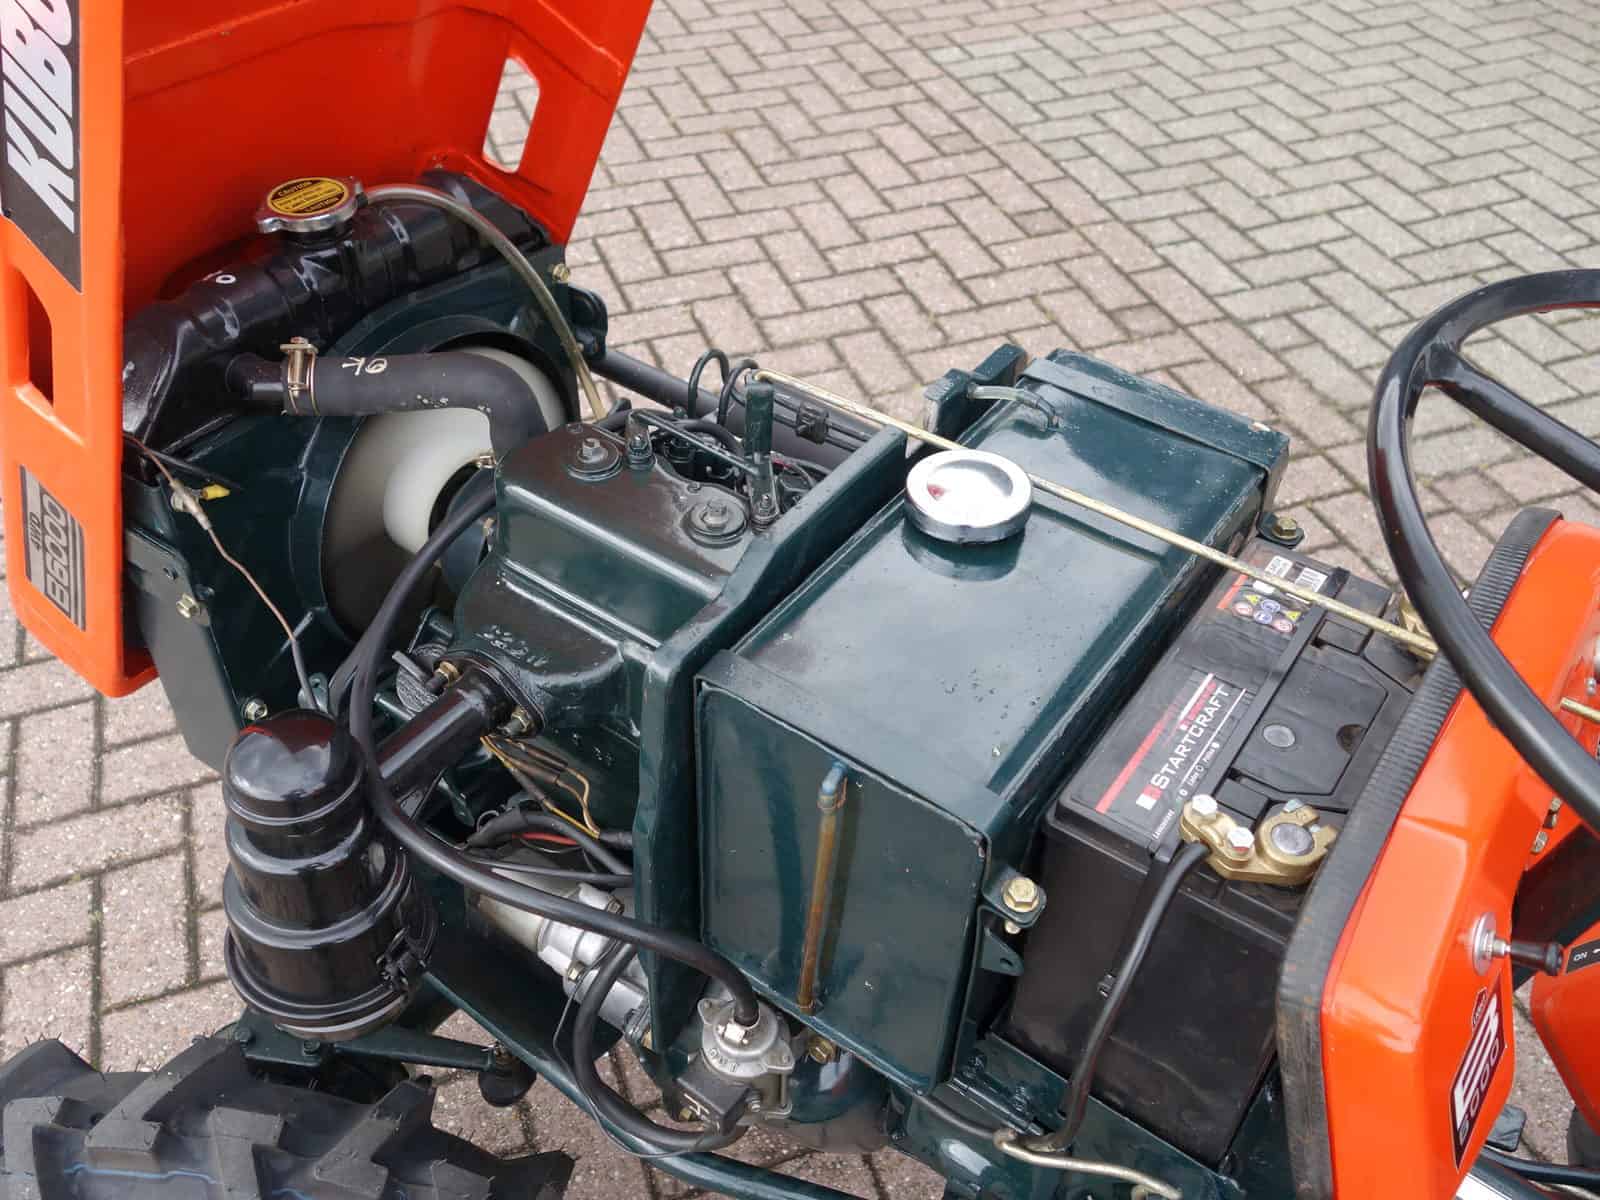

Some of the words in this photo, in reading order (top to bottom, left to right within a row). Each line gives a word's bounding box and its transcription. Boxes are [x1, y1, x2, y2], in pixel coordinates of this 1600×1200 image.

[42, 493, 70, 614] B6000
[1151, 684, 1229, 790] STARTCRAFT
[1573, 951, 1588, 961] ON
